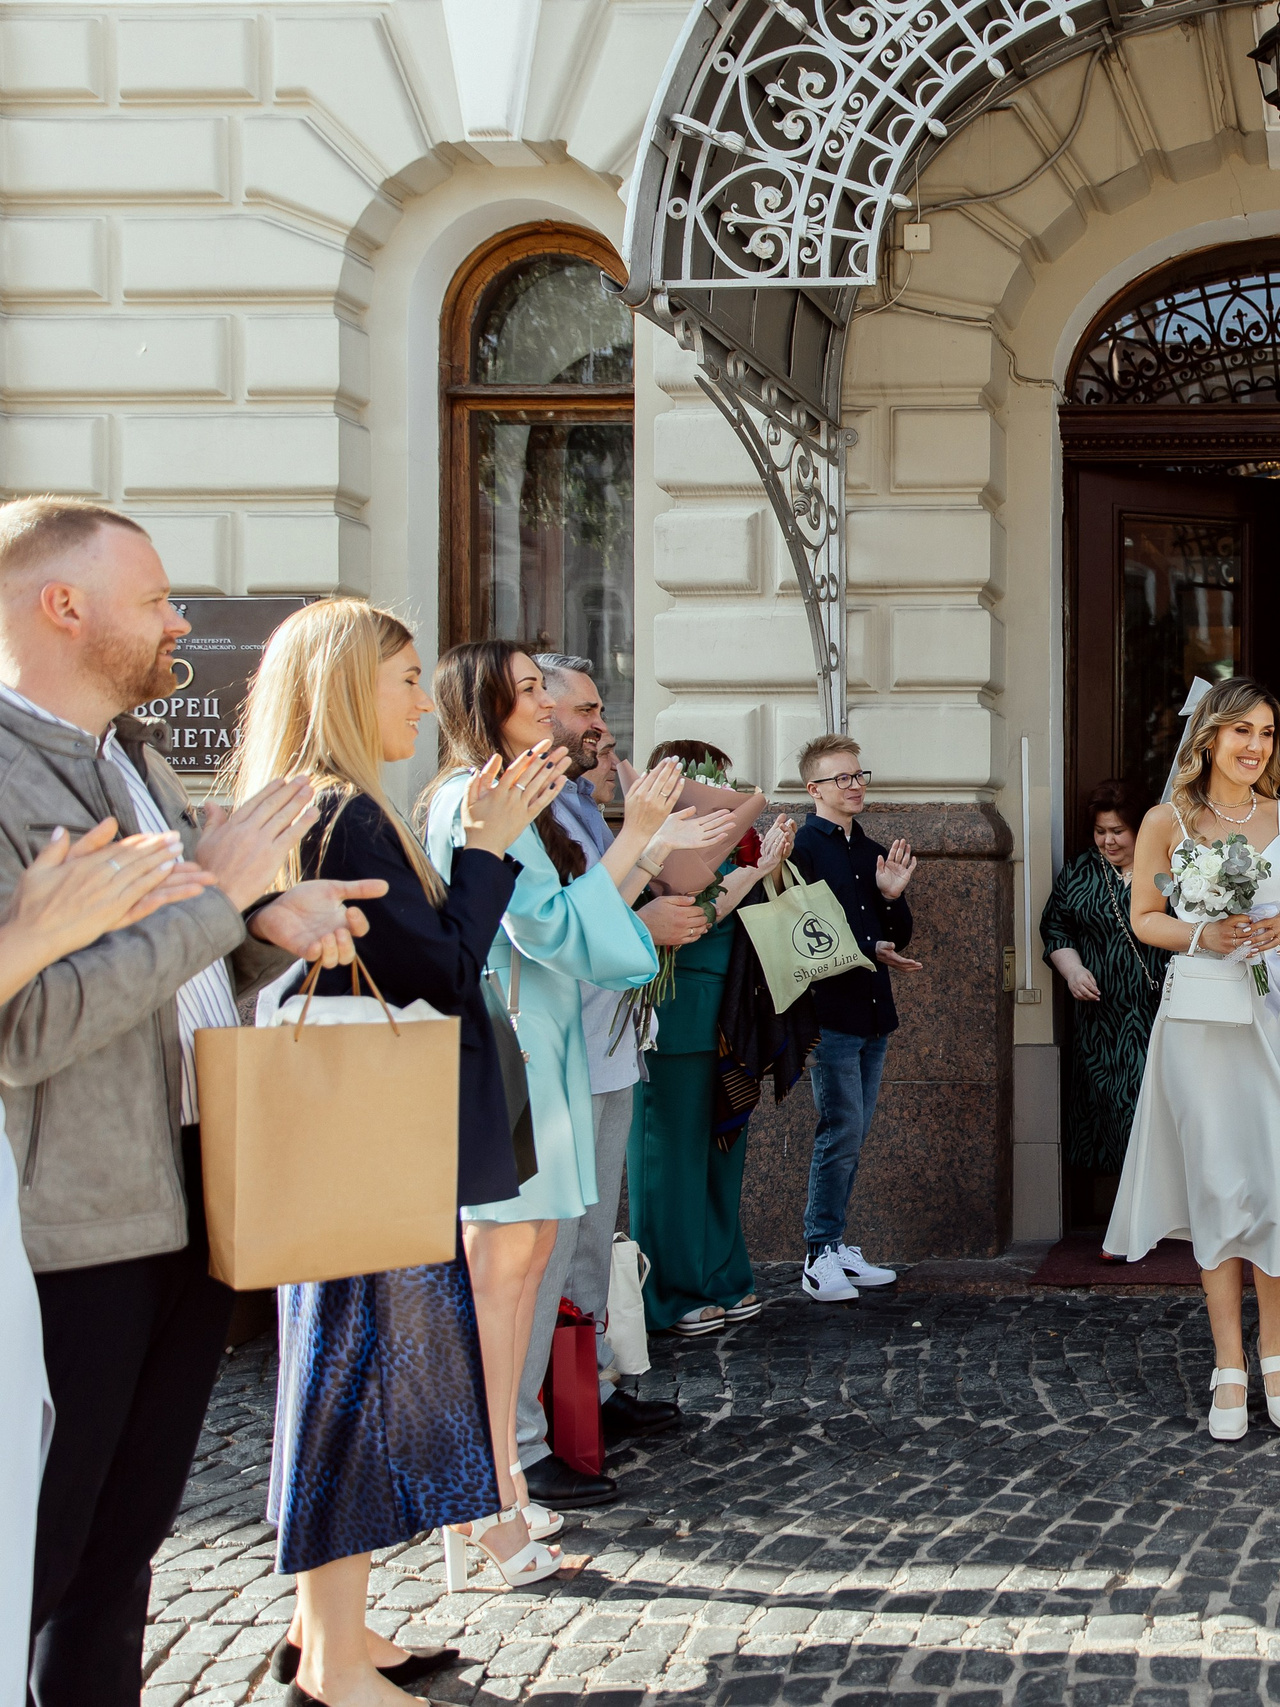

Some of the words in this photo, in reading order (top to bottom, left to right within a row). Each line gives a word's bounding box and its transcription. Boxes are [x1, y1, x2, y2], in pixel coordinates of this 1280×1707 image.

[133, 697, 221, 719] ВОРЕЦ
[204, 754, 221, 765] 52
[793, 963, 829, 983] Shoes
[833, 952, 859, 968] Line
